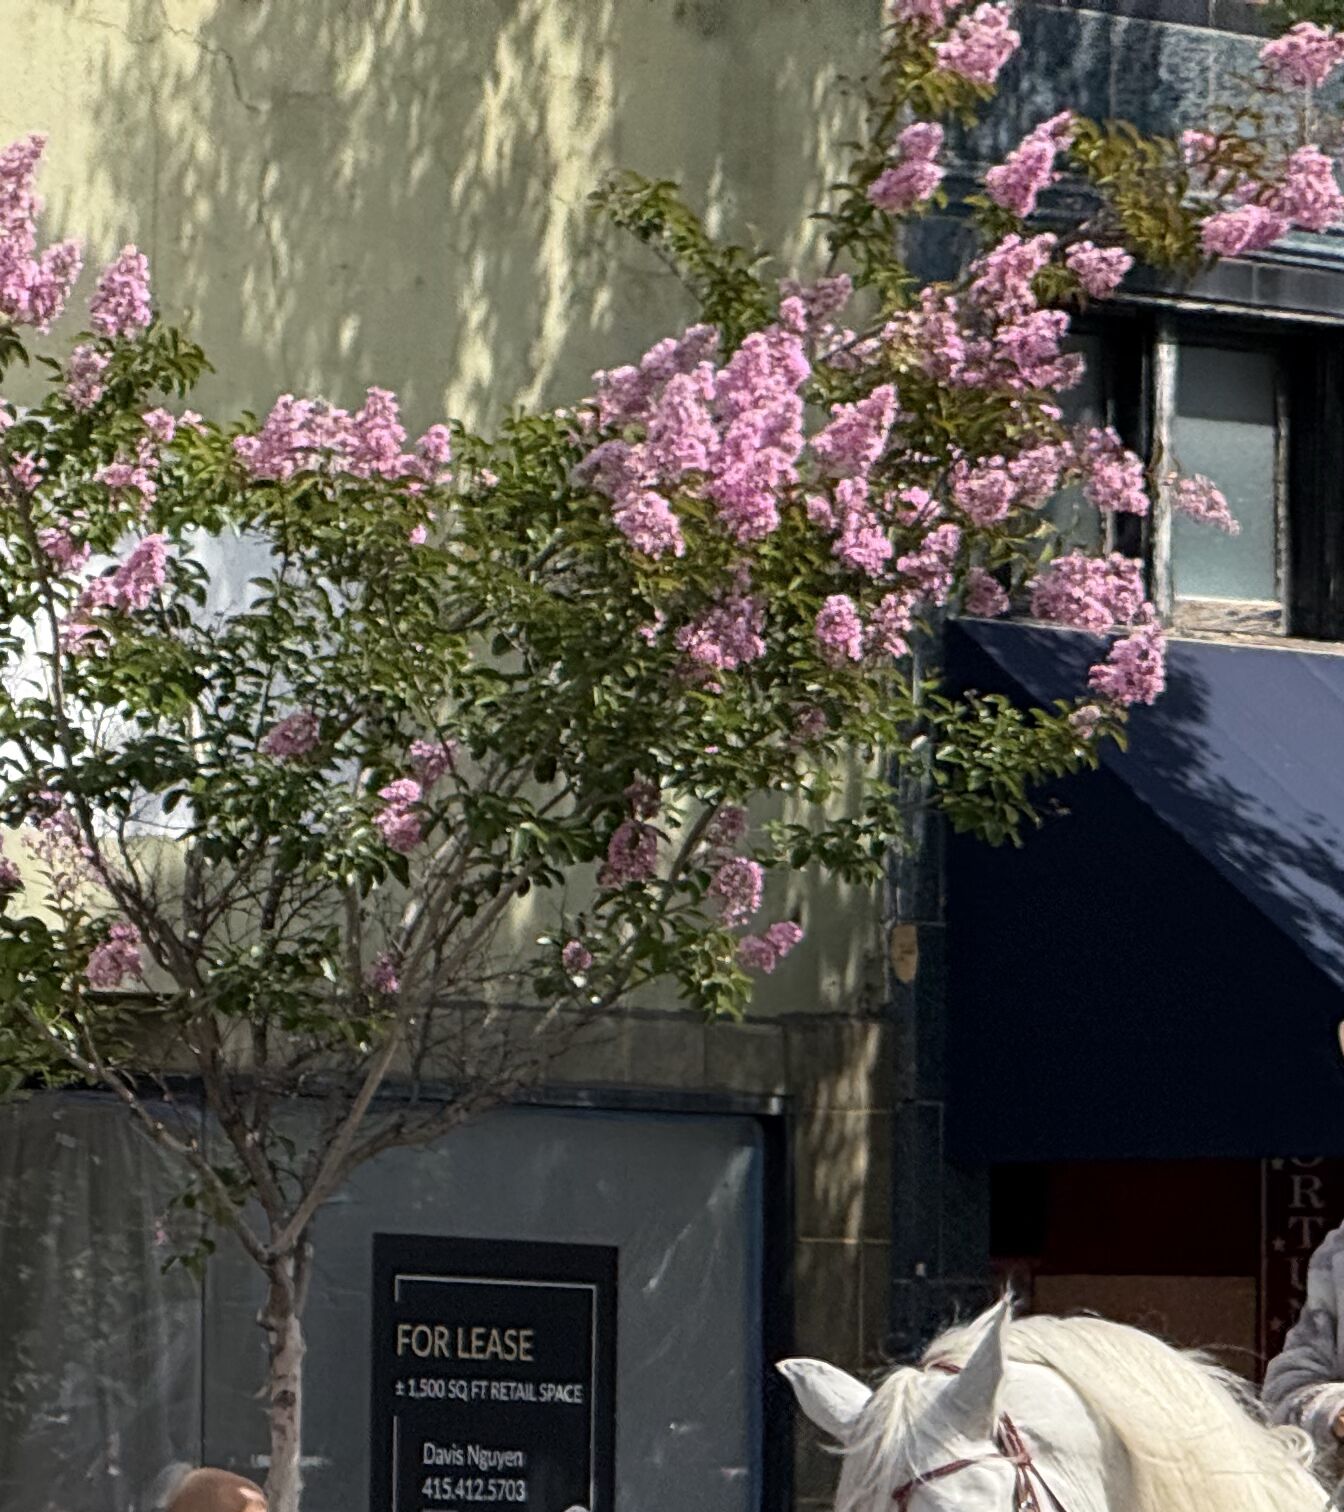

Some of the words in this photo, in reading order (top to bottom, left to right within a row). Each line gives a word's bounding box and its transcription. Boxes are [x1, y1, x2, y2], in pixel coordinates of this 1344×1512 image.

[396, 1323, 450, 1359] FOR
[456, 1326, 535, 1362] LEASE
[448, 1379, 468, 1402] SQ
[471, 1380, 489, 1399] FT
[491, 1381, 537, 1401] RETAIL
[539, 1382, 584, 1404] SPACE
[423, 1442, 465, 1466] Davis
[467, 1444, 524, 1471] Nguyen
[421, 1476, 527, 1501] 415.412.5703
